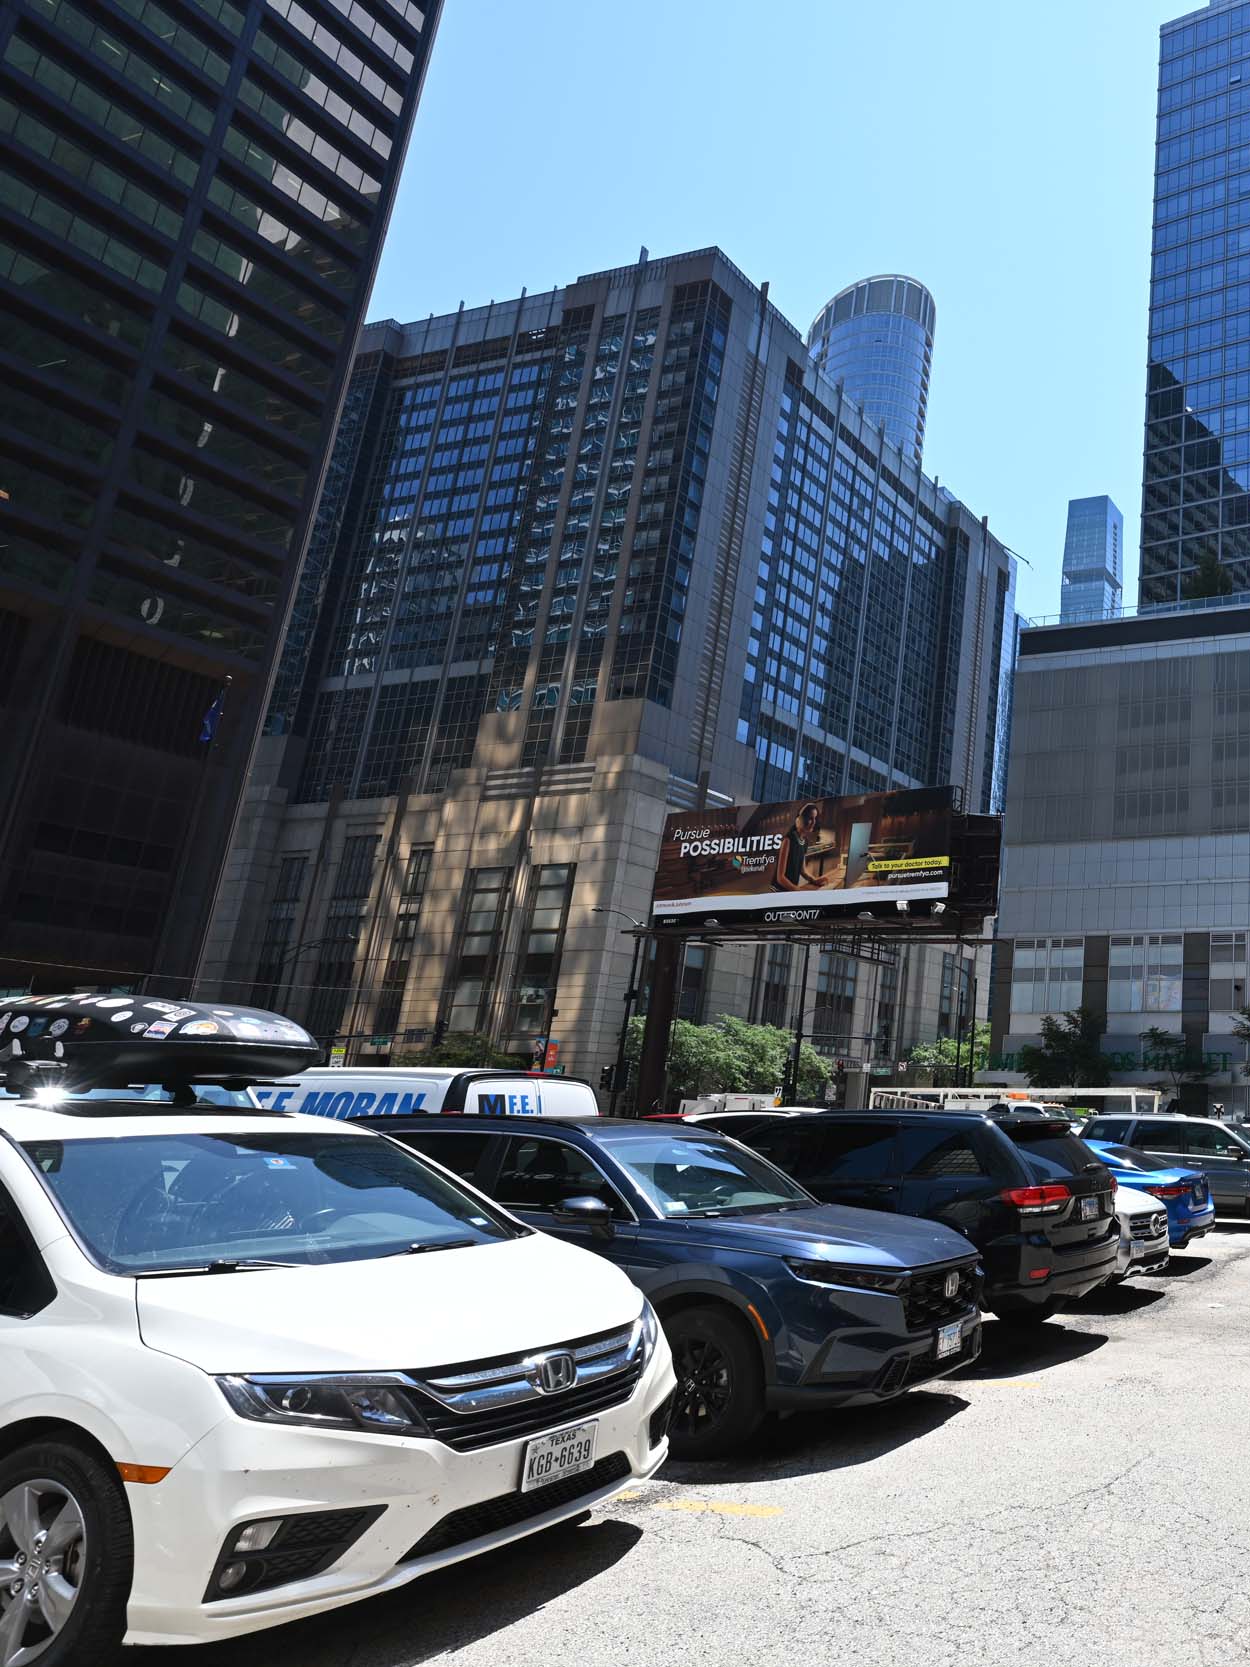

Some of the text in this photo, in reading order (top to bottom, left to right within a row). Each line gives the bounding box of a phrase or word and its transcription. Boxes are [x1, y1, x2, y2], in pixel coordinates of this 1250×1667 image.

[673, 828, 710, 841] Pursue
[679, 833, 784, 858] POSSIBILITIES
[742, 854, 775, 866] Tremfya
[887, 869, 943, 880] pursuetremfya.com
[298, 1091, 427, 1120] MORAN
[508, 1095, 534, 1114] F.E.
[550, 1432, 577, 1447] TEXAS
